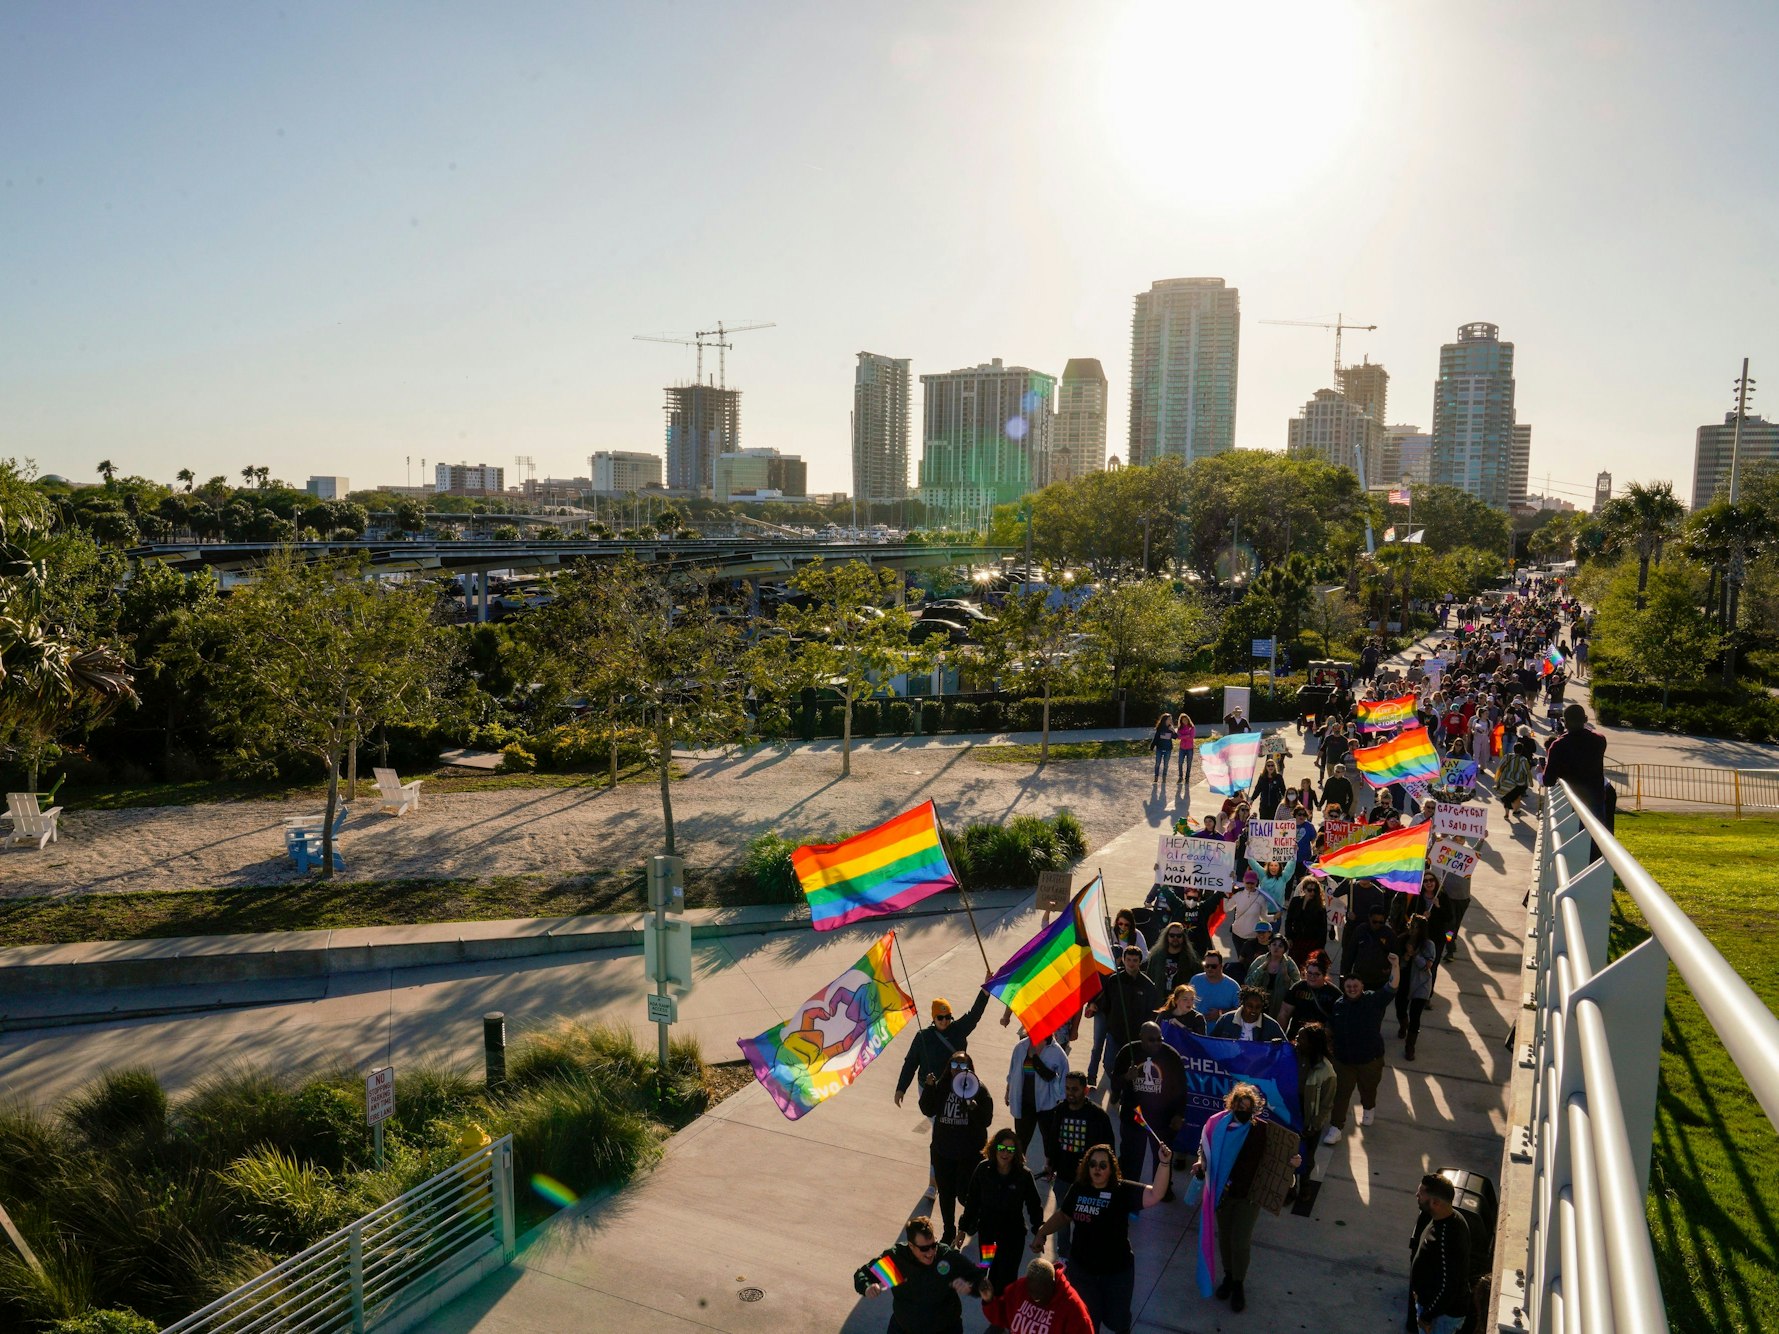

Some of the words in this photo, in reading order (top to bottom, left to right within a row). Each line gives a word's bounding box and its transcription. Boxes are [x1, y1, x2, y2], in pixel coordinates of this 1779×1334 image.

[1447, 773, 1473, 786] GAY
[1437, 805, 1453, 813] GAY
[1453, 807, 1469, 817] GAY
[1250, 822, 1273, 837] TEACH
[1165, 838, 1225, 854] HEATHER
[1274, 838, 1296, 847] RIGHTS
[1272, 847, 1296, 855] PROTECT
[1440, 846, 1463, 859] PROUD
[1464, 854, 1474, 863] TO
[1167, 851, 1213, 867] already
[1437, 855, 1451, 865] SAY
[1451, 860, 1469, 872] GAY
[1165, 864, 1185, 872] has
[1192, 864, 1210, 875] 2
[1163, 874, 1224, 887] MOMMIES
[375, 1073, 385, 1085] NO
[371, 1090, 391, 1104] PARKING
[371, 1102, 380, 1112] ANY
[381, 1097, 391, 1106] TIME
[370, 1112, 380, 1121] FIRE
[381, 1106, 392, 1118] LANE
[1077, 1195, 1111, 1208] PROTECT
[1075, 1203, 1100, 1215] TRANS
[1073, 1212, 1091, 1222] KIDS
[1017, 1300, 1055, 1325] JUSTICE
[1010, 1312, 1049, 1334] OVER
